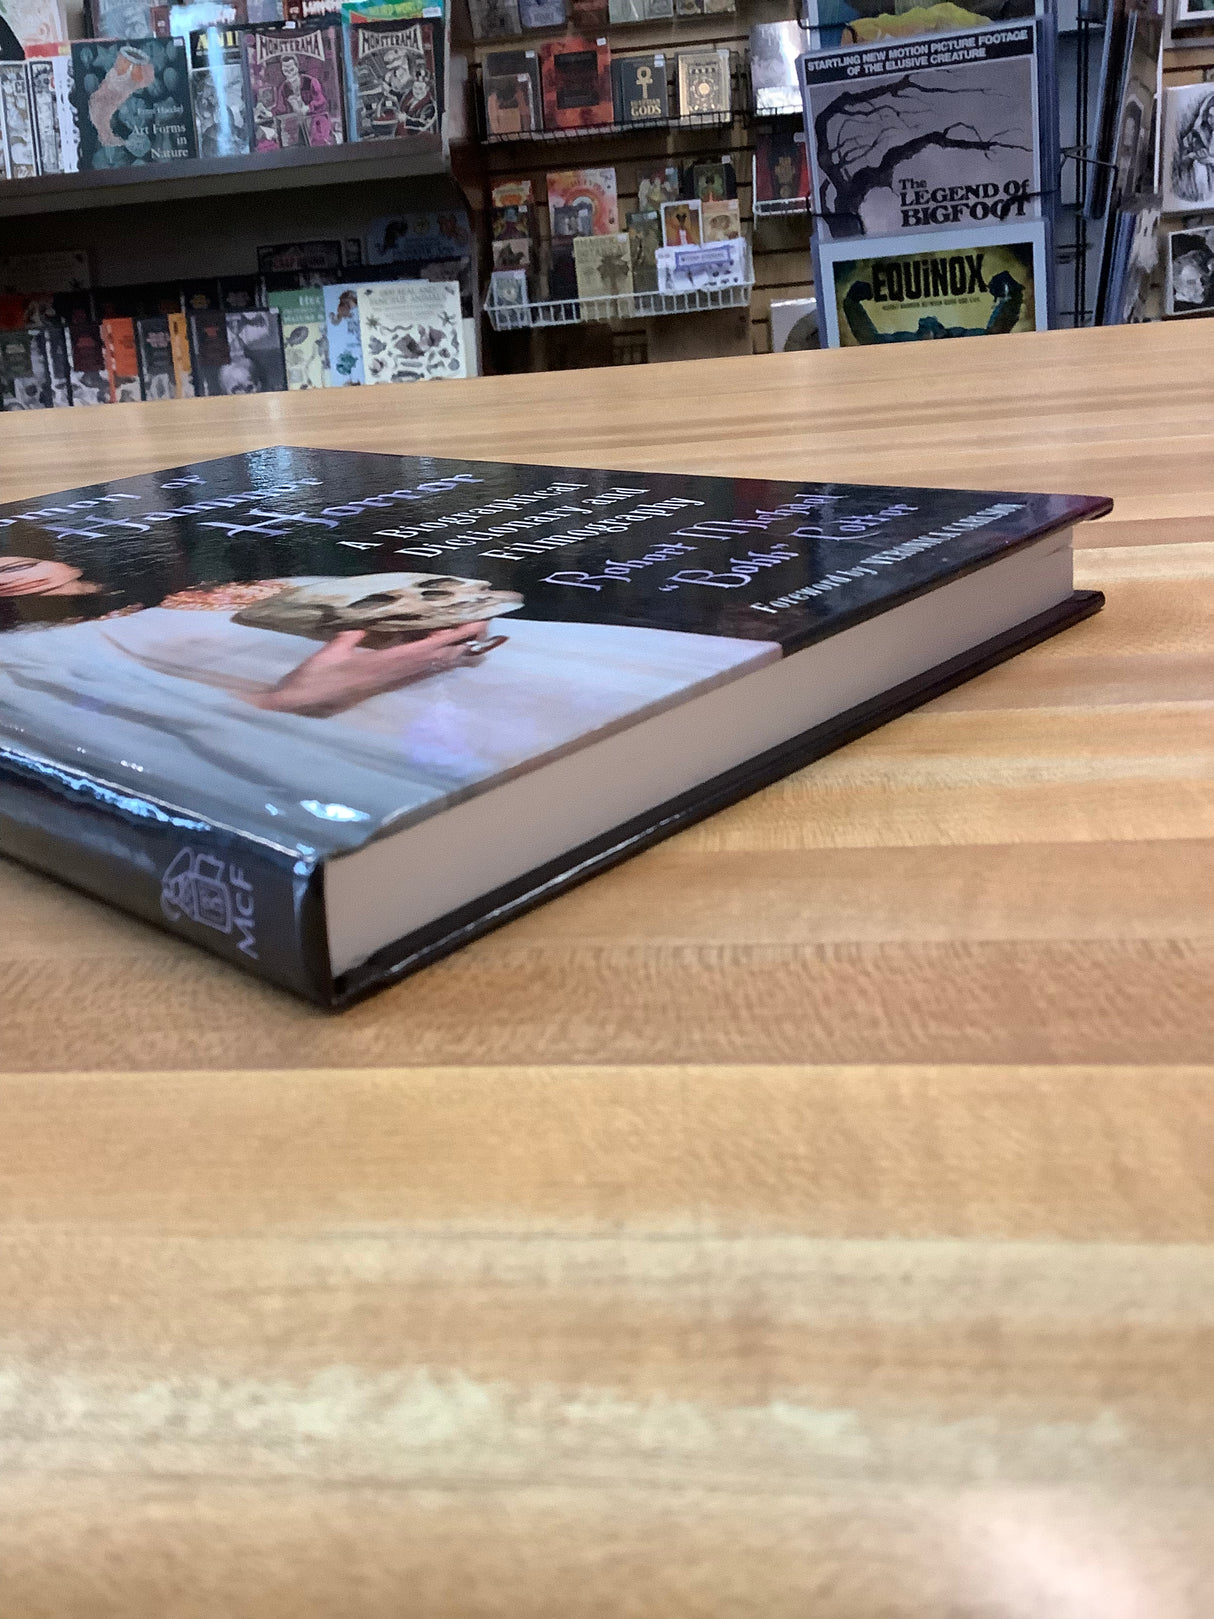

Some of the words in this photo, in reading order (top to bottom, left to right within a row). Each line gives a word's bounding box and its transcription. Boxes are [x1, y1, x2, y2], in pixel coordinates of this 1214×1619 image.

[257, 31, 324, 64] MONSTERAMA
[361, 25, 422, 56] MONSTERAMA
[807, 54, 862, 72] STARTLING
[862, 50, 886, 63] NEW
[888, 44, 929, 59] MOTION
[930, 37, 976, 52] PICTURE
[978, 29, 1029, 46] FOOTAGE
[846, 66, 863, 77] OF
[864, 61, 884, 74] THE
[886, 55, 929, 71] ELUSIVE
[930, 47, 987, 65] CREATURE
[630, 104, 662, 117] GODS
[131, 124, 150, 135] Art
[152, 123, 187, 135] Forms
[176, 134, 188, 145] in
[150, 147, 189, 159] Nature
[899, 177, 928, 191] The
[899, 181, 1001, 207] LEGEND
[900, 196, 1030, 228] BIGFOOT
[0, 493, 142, 528] omen
[160, 475, 208, 490] of
[42, 477, 324, 540] Hammer
[197, 473, 485, 538] Horror
[336, 539, 384, 551] A
[372, 481, 590, 540] Biographical
[393, 503, 594, 558] Dictionary
[581, 487, 652, 507] and
[478, 496, 706, 562] Filmography
[788, 502, 920, 542] Cotter
[538, 541, 699, 592] Robert
[669, 493, 850, 541] Michael
[750, 570, 852, 615] Foreword
[842, 564, 879, 580] by
